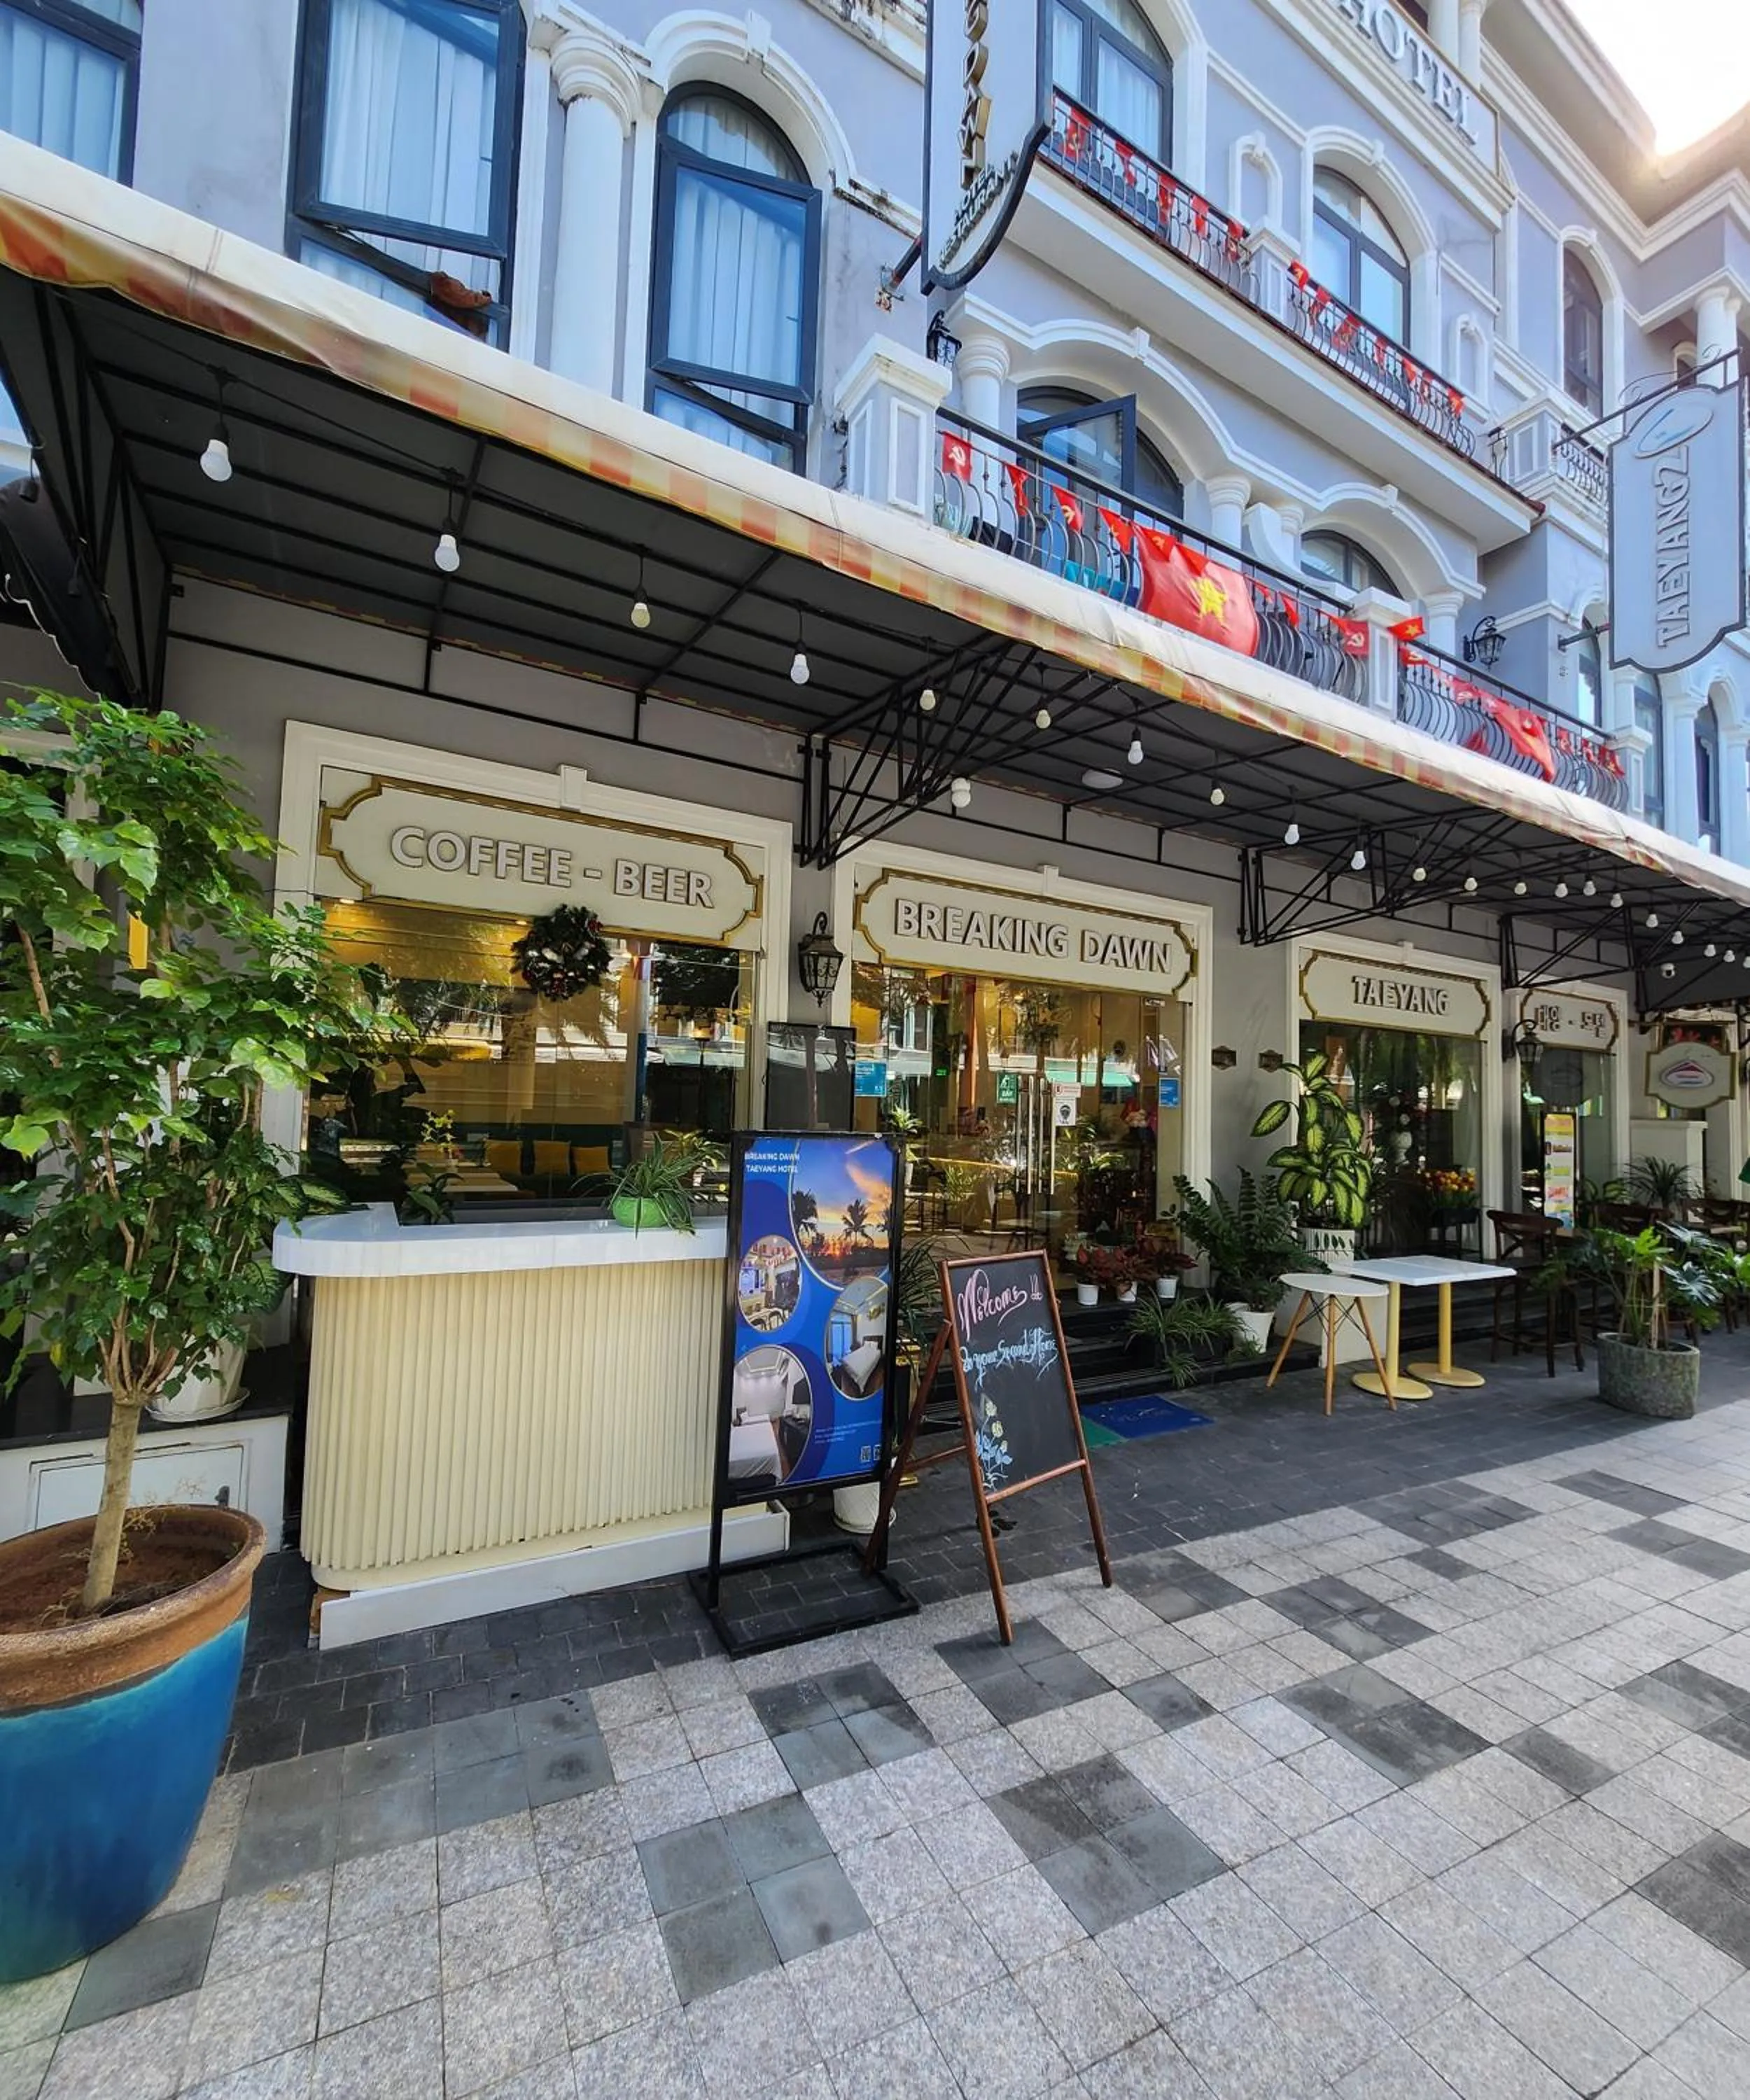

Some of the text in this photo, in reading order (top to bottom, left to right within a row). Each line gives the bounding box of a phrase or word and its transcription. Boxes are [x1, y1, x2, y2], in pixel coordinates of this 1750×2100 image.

[390, 825, 573, 889] COFFEE
[613, 857, 715, 909] BEER
[895, 898, 1172, 974] BREAKING DAWN
[1351, 975, 1450, 1016] TAEYANG
[744, 1152, 778, 1161] BREAKING
[746, 1163, 799, 1173] TAEYANG HOTEL
